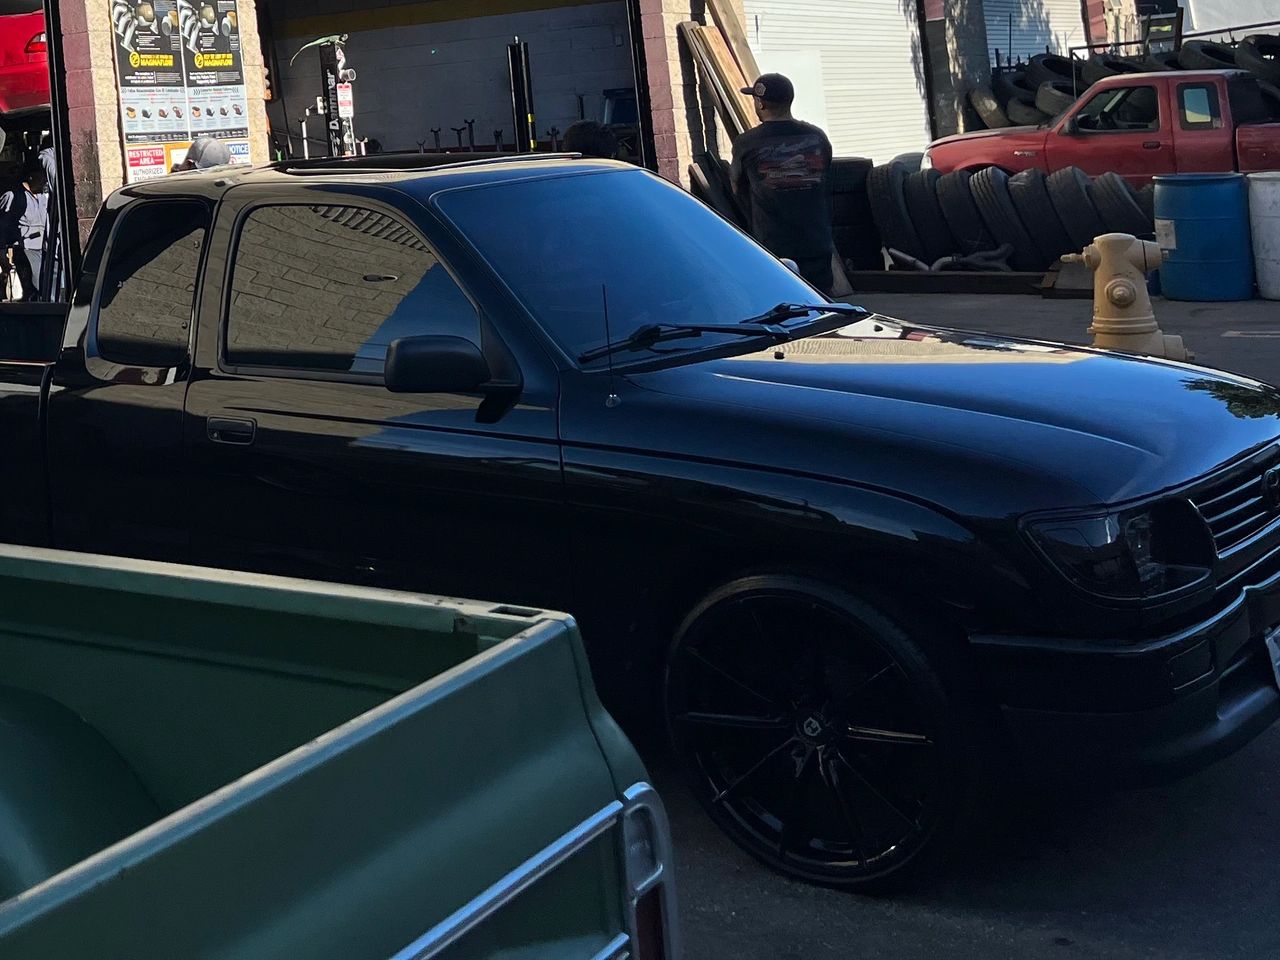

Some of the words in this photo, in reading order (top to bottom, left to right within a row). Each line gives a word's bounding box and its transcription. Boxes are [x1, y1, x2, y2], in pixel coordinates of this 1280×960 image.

[327, 71, 340, 130] Dannmar
[128, 148, 164, 159] RESTRICTED
[139, 157, 155, 165] AREA
[132, 167, 164, 176] AUTHORIZED
